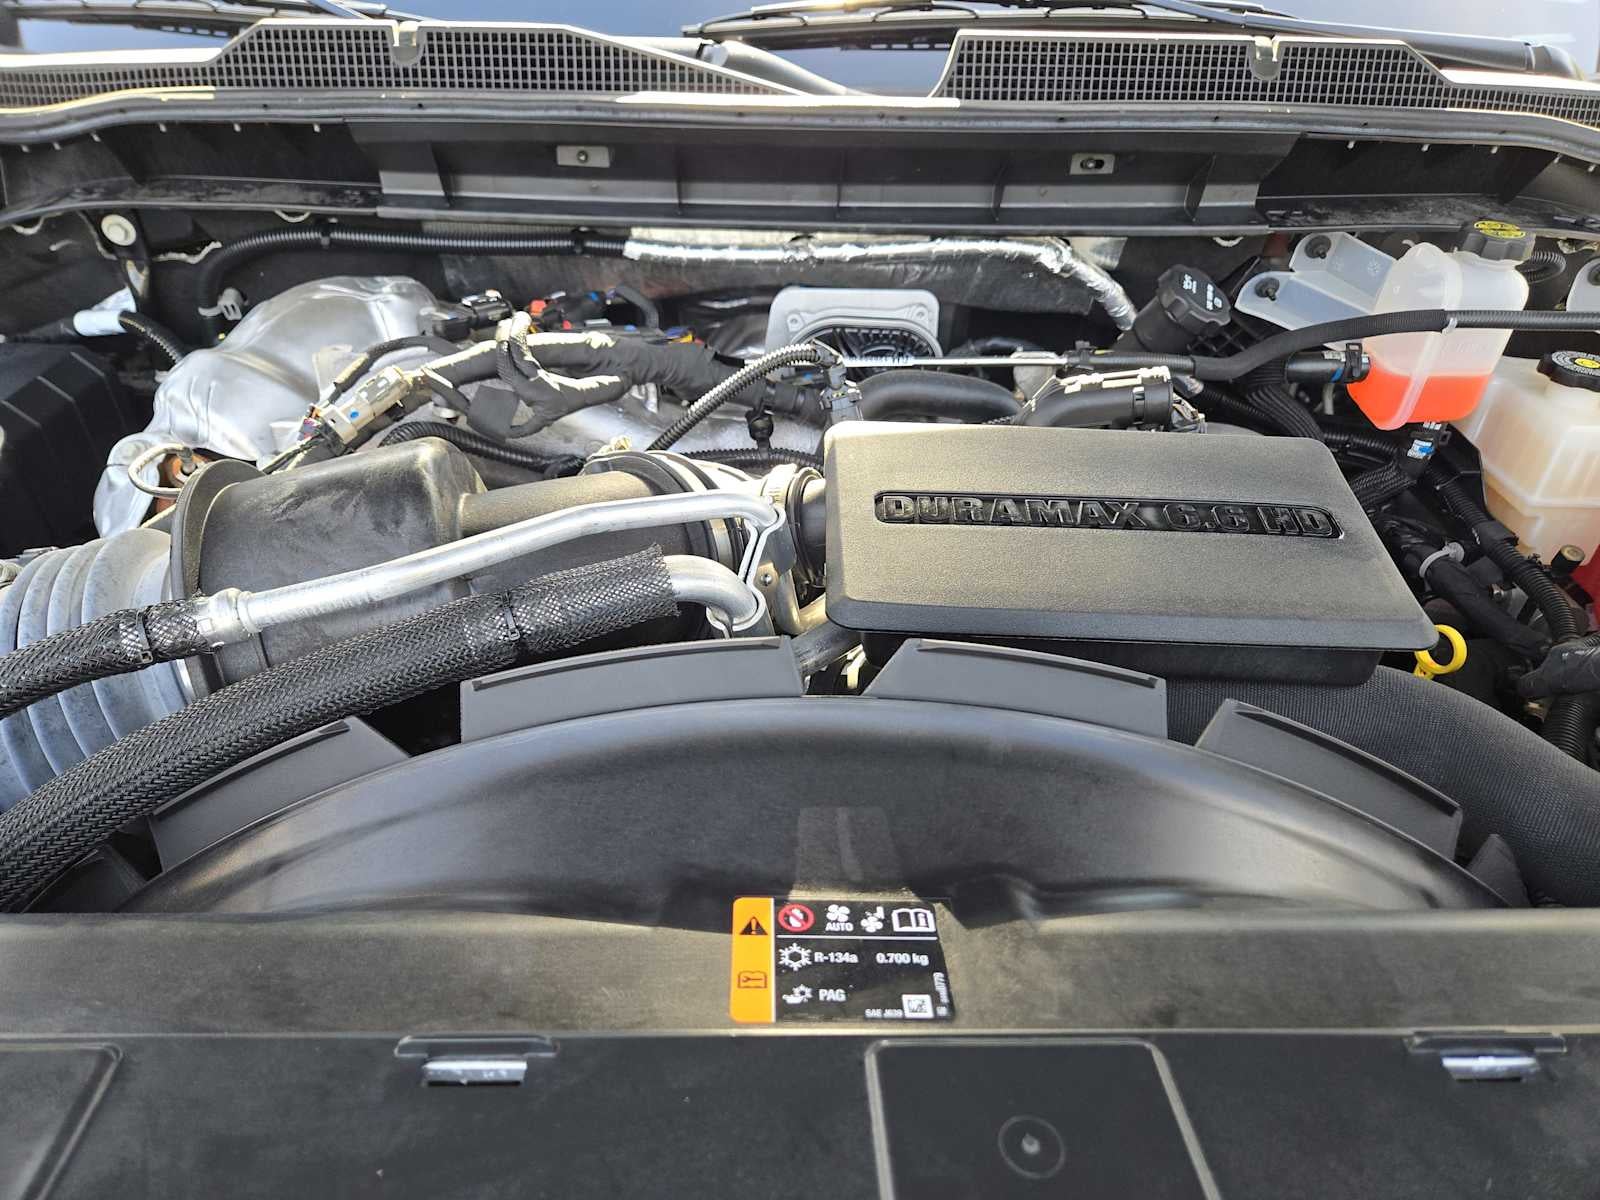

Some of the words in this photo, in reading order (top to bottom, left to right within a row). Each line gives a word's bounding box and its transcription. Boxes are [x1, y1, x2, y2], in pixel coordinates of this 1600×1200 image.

[880, 494, 1147, 530] DURAMAX
[1162, 503, 1250, 533] 6.6
[1256, 504, 1336, 536] HD
[825, 921, 854, 932] AUTO
[813, 952, 858, 963] R-134a
[876, 953, 911, 964] 0.700
[912, 953, 930, 966] kg
[818, 988, 846, 1001] PAG
